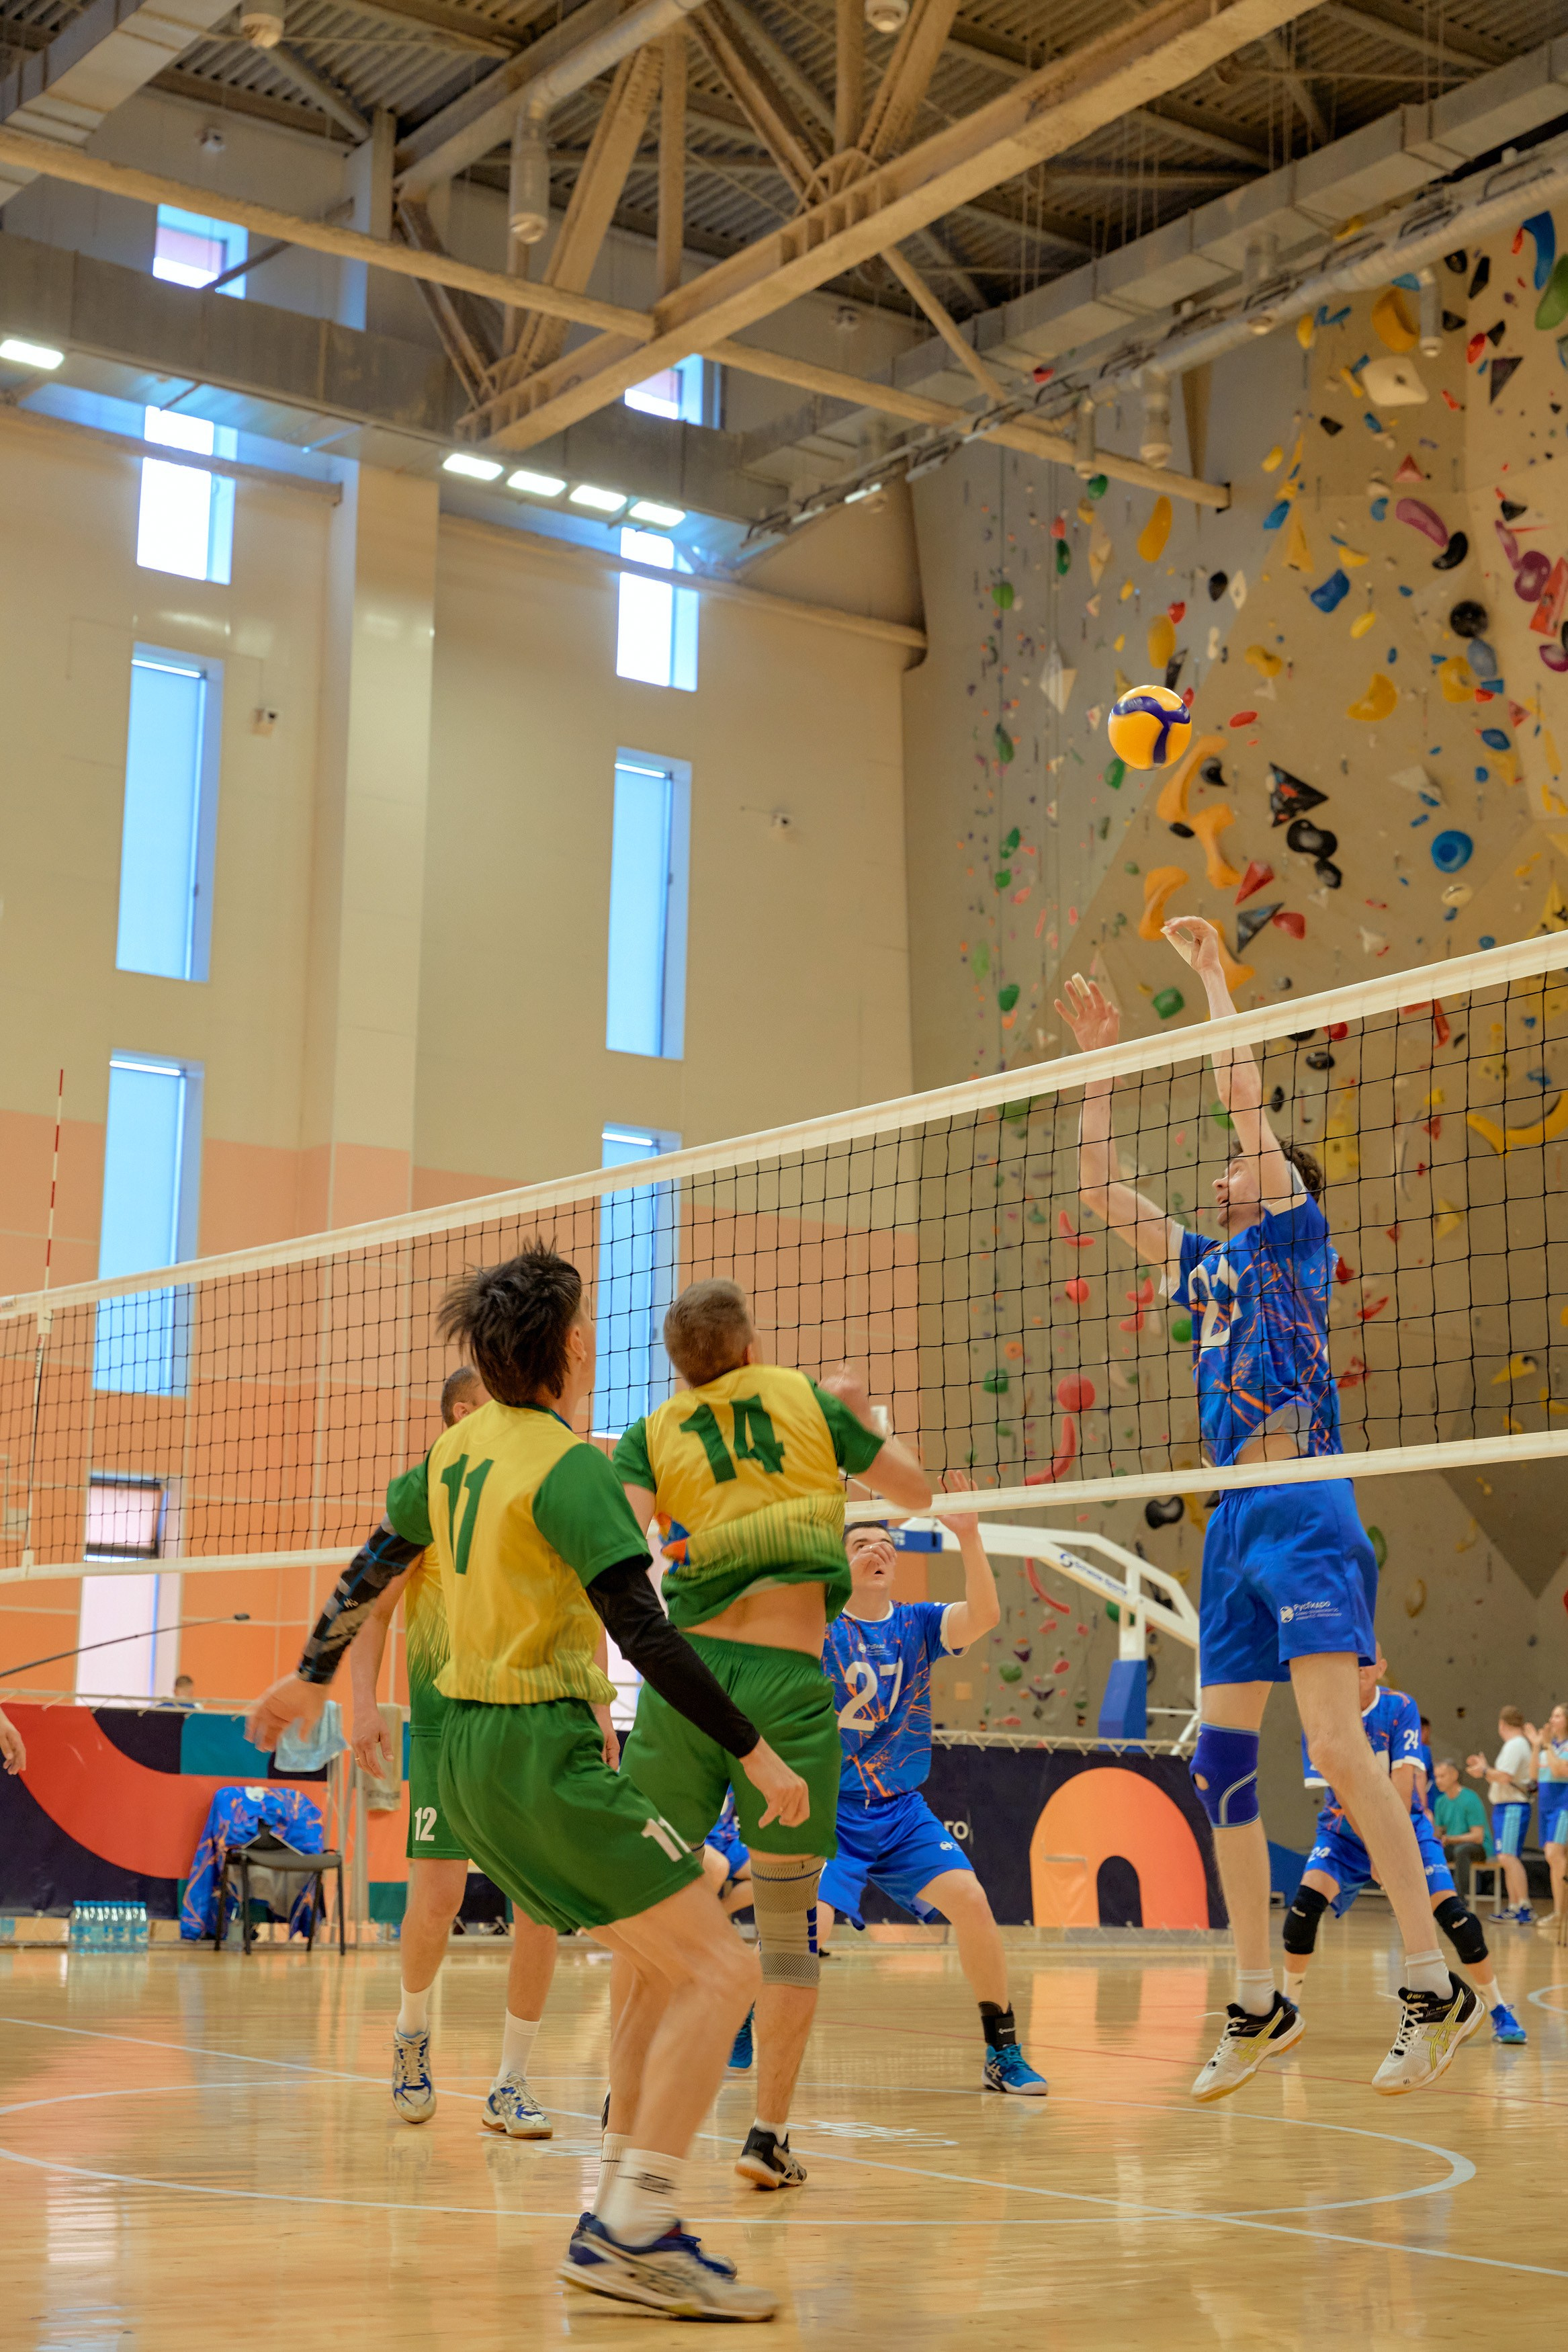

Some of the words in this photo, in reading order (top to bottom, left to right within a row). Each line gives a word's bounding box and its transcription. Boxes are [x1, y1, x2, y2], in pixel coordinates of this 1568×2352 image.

[679, 1393, 785, 1484] 14
[441, 1454, 494, 1575] 11
[838, 1657, 904, 1731] 27
[1403, 1729, 1419, 1751] 24
[415, 1807, 437, 1841] 12
[641, 1815, 692, 1862] 11
